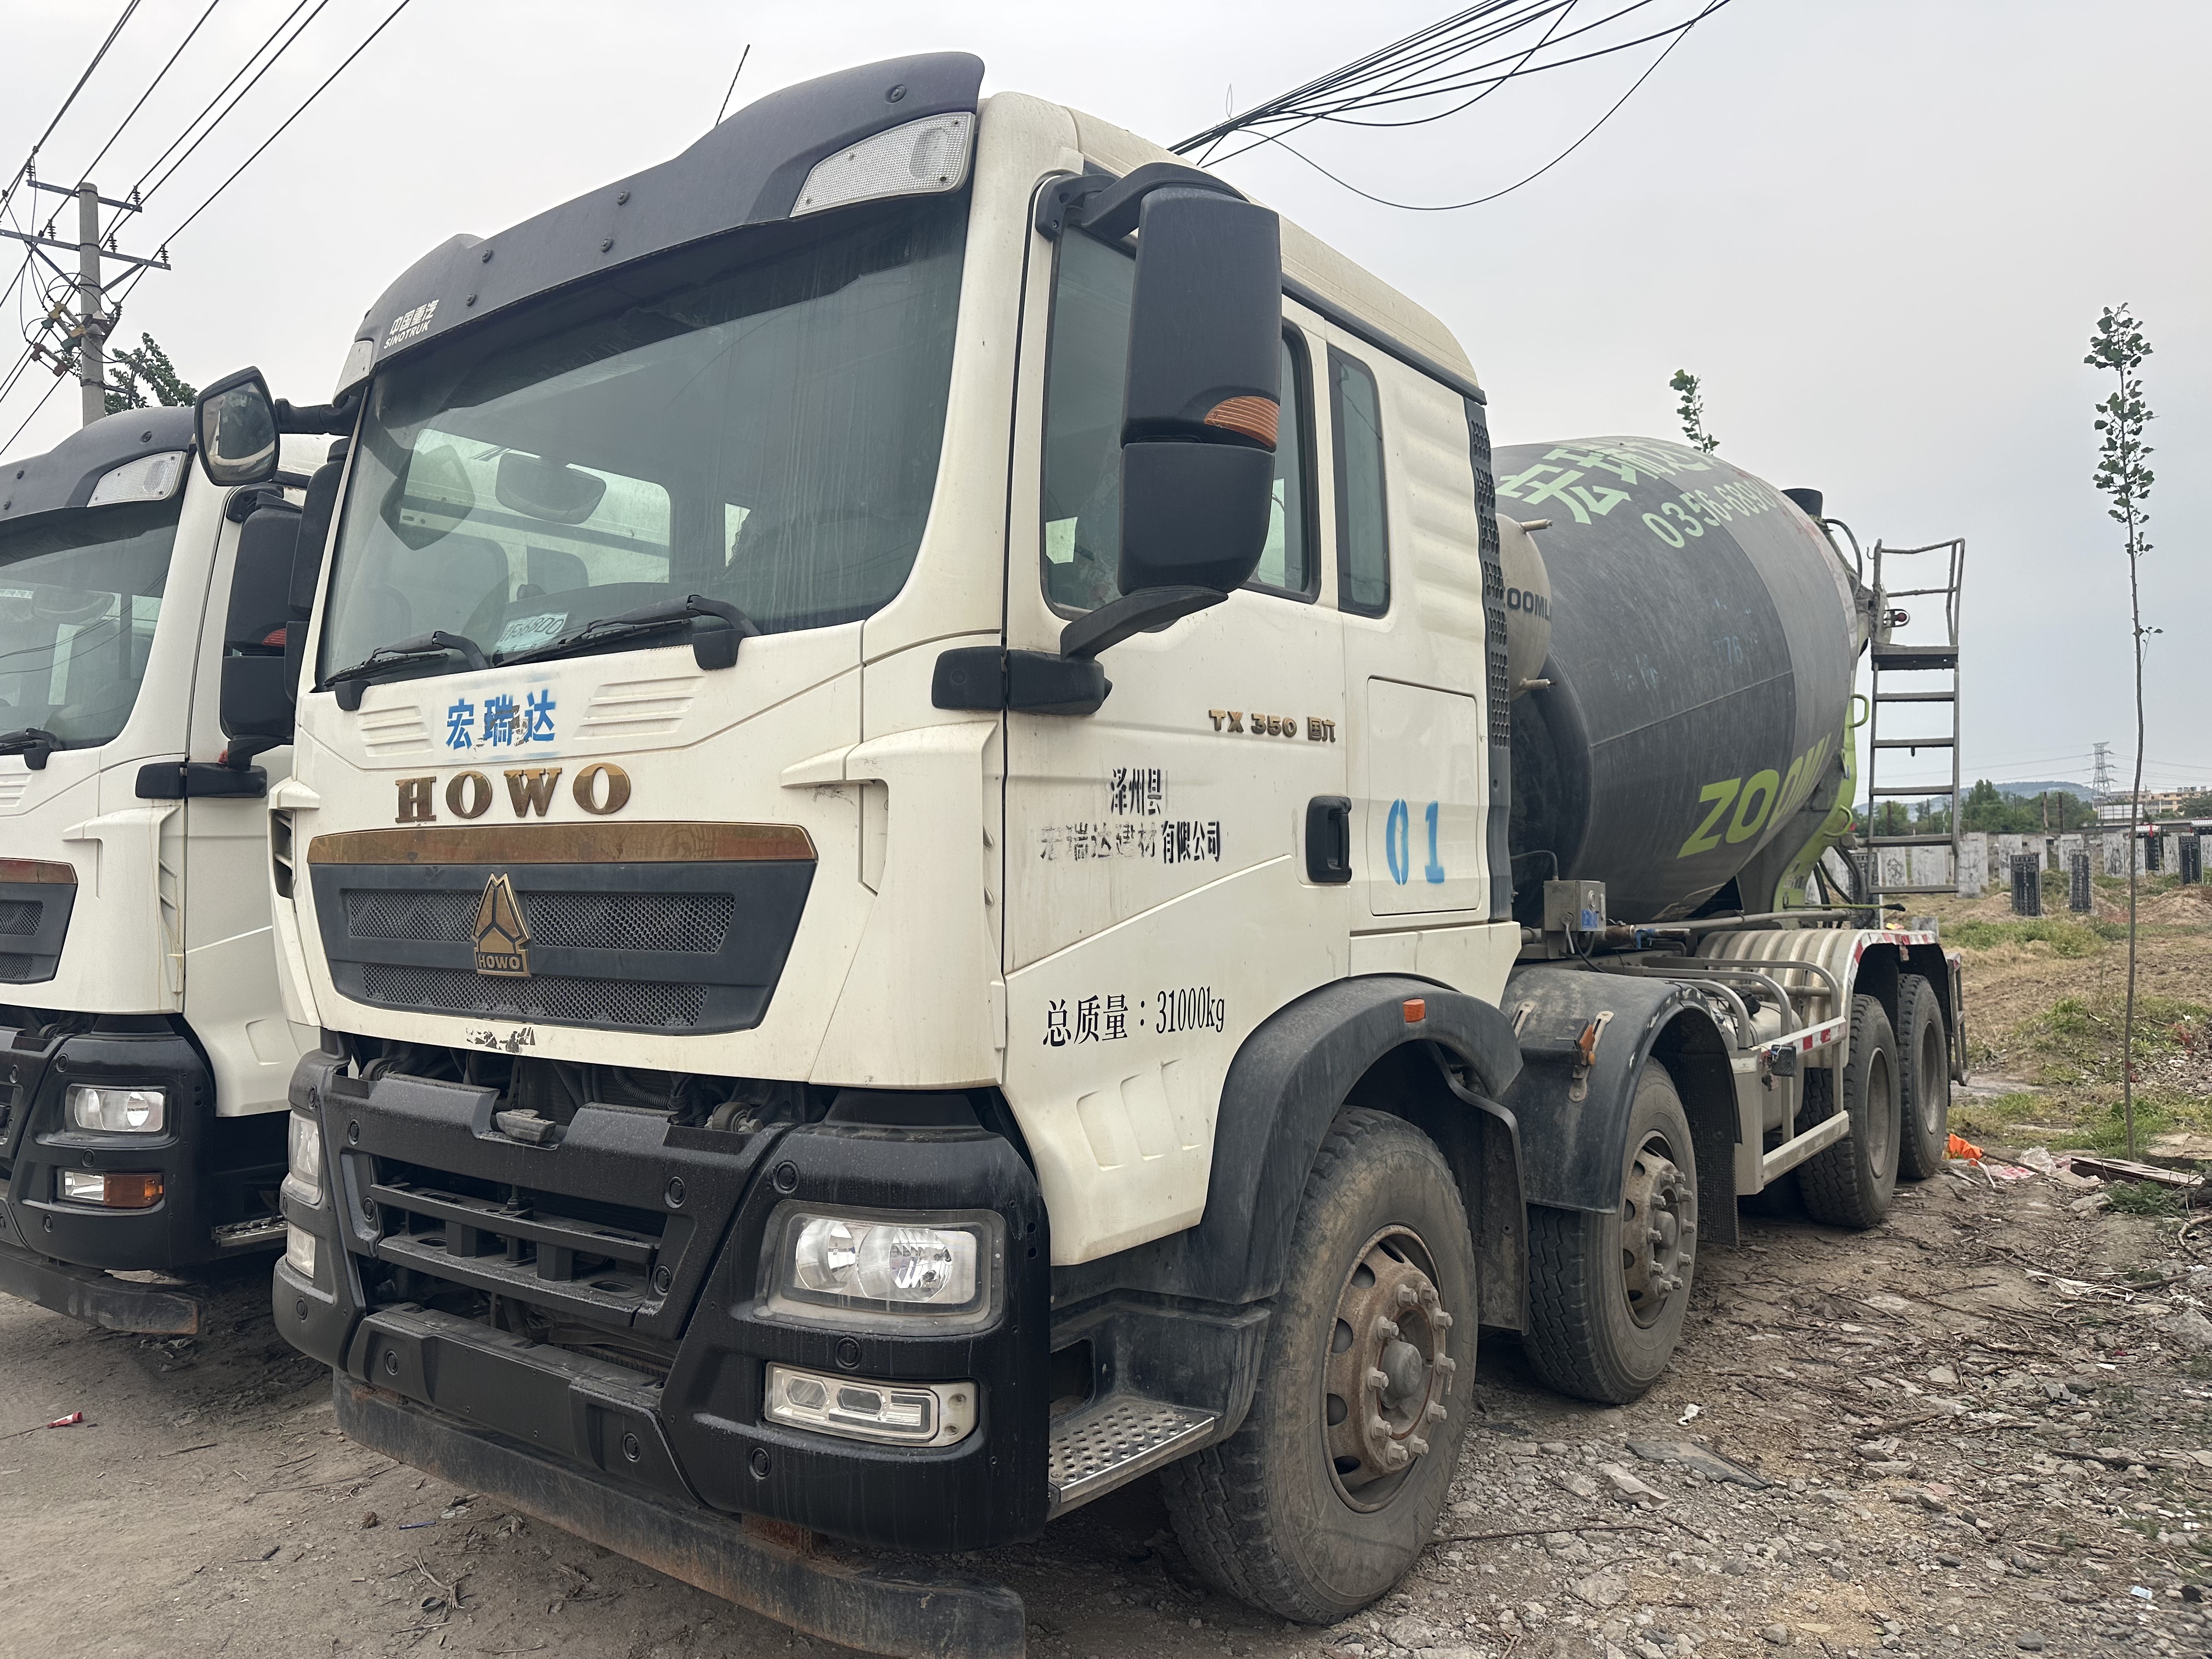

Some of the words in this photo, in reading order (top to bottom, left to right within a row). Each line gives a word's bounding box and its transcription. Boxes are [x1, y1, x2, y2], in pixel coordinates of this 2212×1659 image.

[384, 320, 431, 349] SINOTRUK
[389, 299, 439, 335] 中国重汽
[445, 689, 556, 750] 宏瑞达
[1209, 709, 1244, 732] TX
[1251, 713, 1297, 737] 350
[1306, 716, 1336, 742] 国六
[395, 763, 631, 823] HOWO
[1110, 768, 1161, 816] 泽州县
[1386, 798, 1445, 885] 01
[478, 955, 521, 970] HOWO
